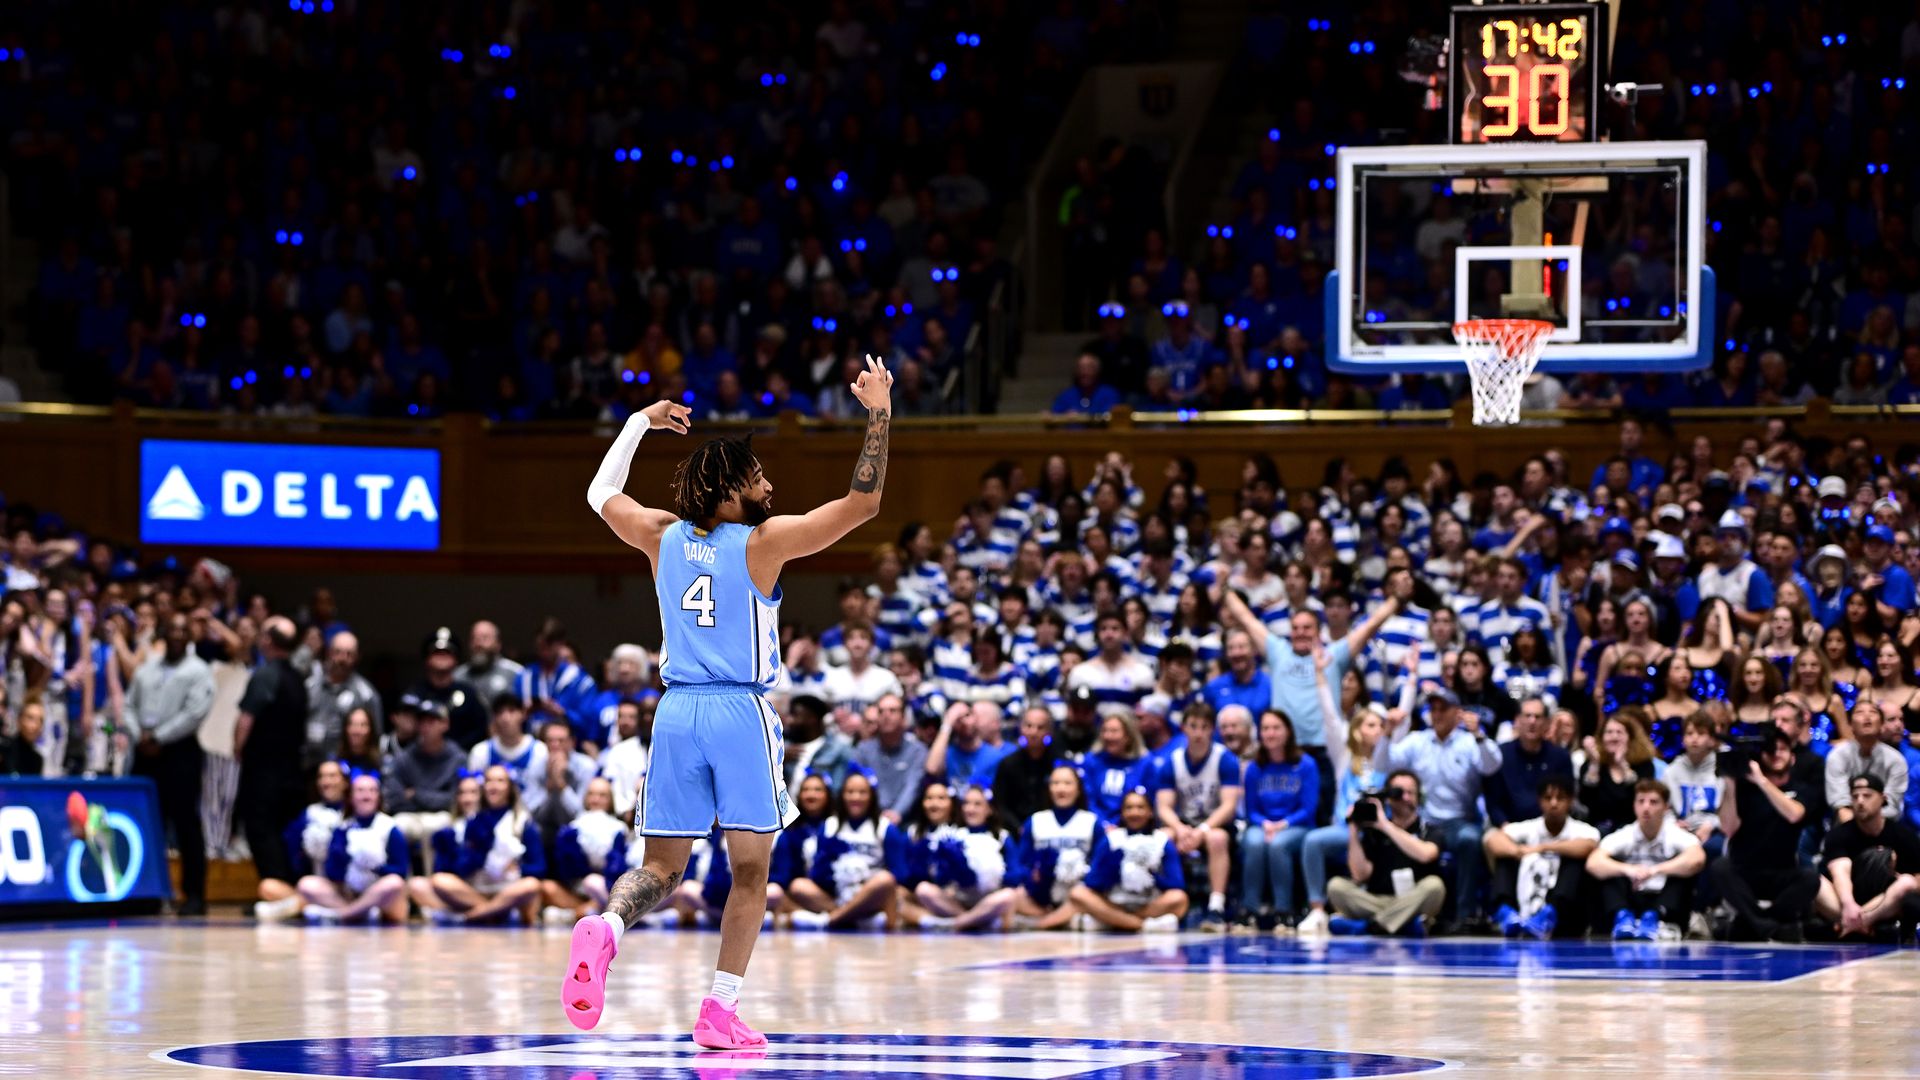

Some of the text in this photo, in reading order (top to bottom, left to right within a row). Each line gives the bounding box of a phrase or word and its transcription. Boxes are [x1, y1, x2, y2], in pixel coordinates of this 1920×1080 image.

[1483, 19, 1582, 60] 17:42
[1482, 64, 1569, 137] 30
[221, 469, 438, 522] DELTA
[684, 542, 717, 564] DAVIS
[681, 574, 716, 627] 4
